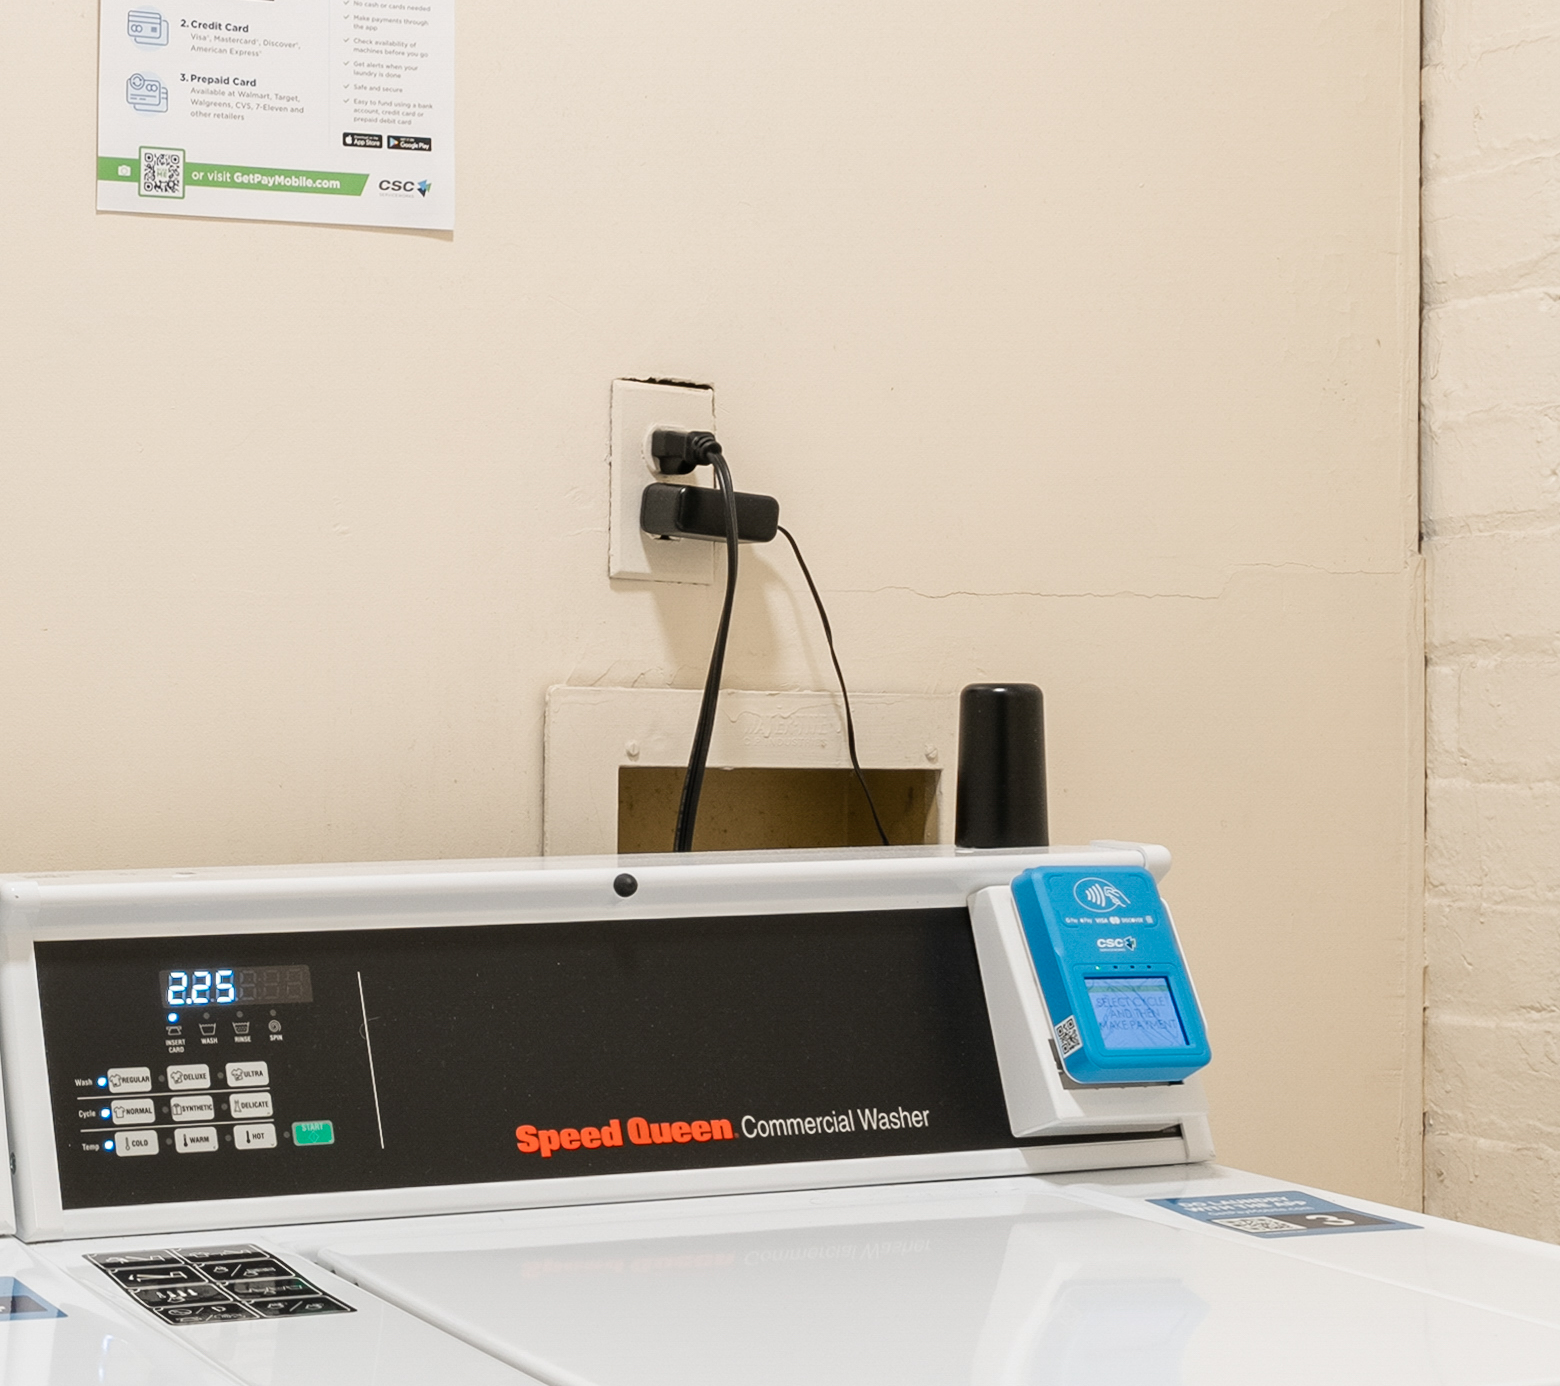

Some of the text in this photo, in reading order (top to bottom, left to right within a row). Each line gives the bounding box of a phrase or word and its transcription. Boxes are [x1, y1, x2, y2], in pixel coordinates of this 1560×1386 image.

[180, 18, 249, 33] 2. Credit Card
[180, 73, 257, 87] 3. Prepaid Card
[191, 170, 341, 189] or visit GetPayMobile.com
[378, 179, 415, 193] CSC
[167, 969, 235, 1005] 2.25
[125, 1107, 153, 1115] NORMAL
[515, 1106, 931, 1157] Speed Queen Commercial Washer
[1306, 1213, 1356, 1226] 3
